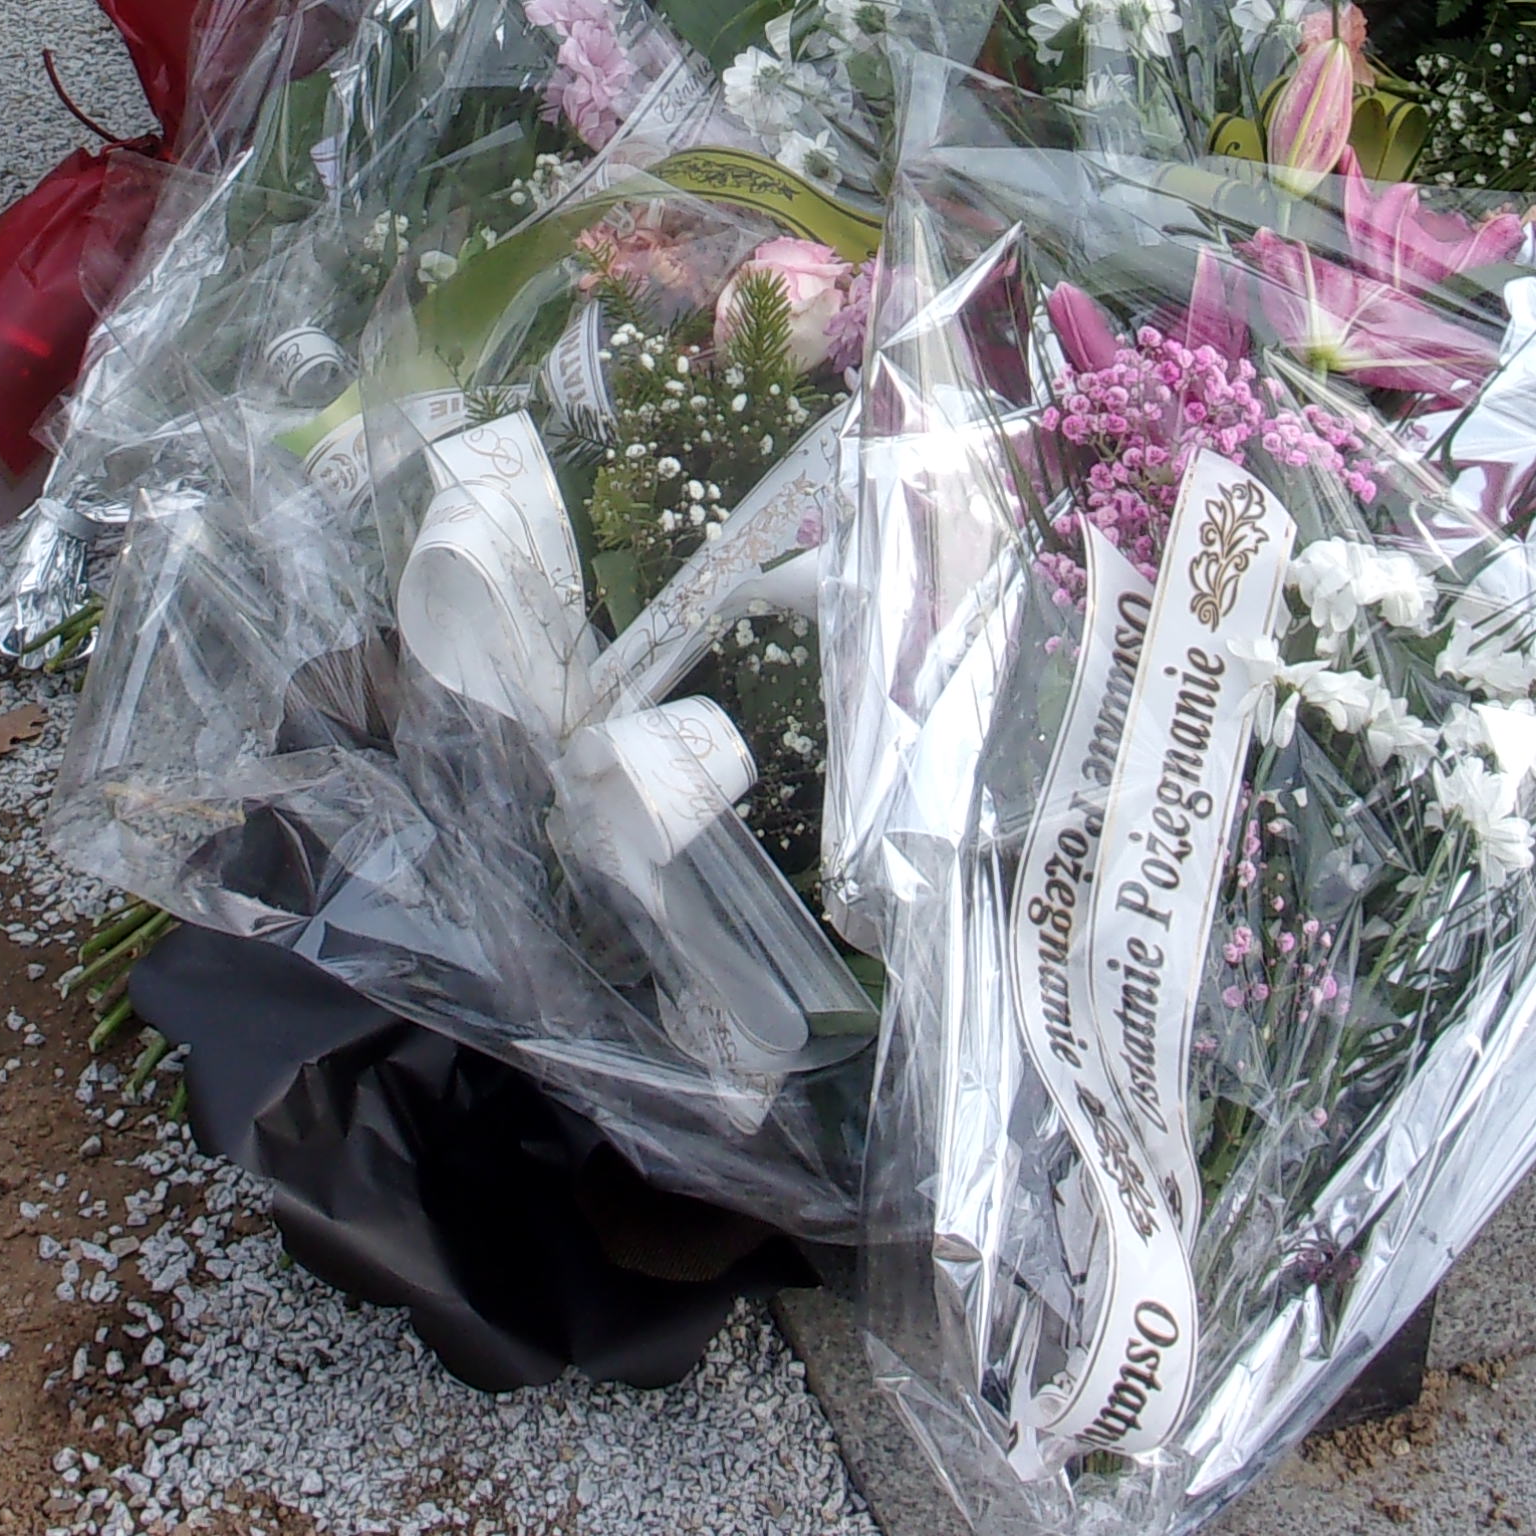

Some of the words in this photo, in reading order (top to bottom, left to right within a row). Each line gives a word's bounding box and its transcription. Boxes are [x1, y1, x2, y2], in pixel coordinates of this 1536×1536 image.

[1116, 646, 1226, 932] Pożegnanie
[1106, 935, 1170, 1135] Ostatnie
[1075, 1299, 1181, 1455] Ostatni
